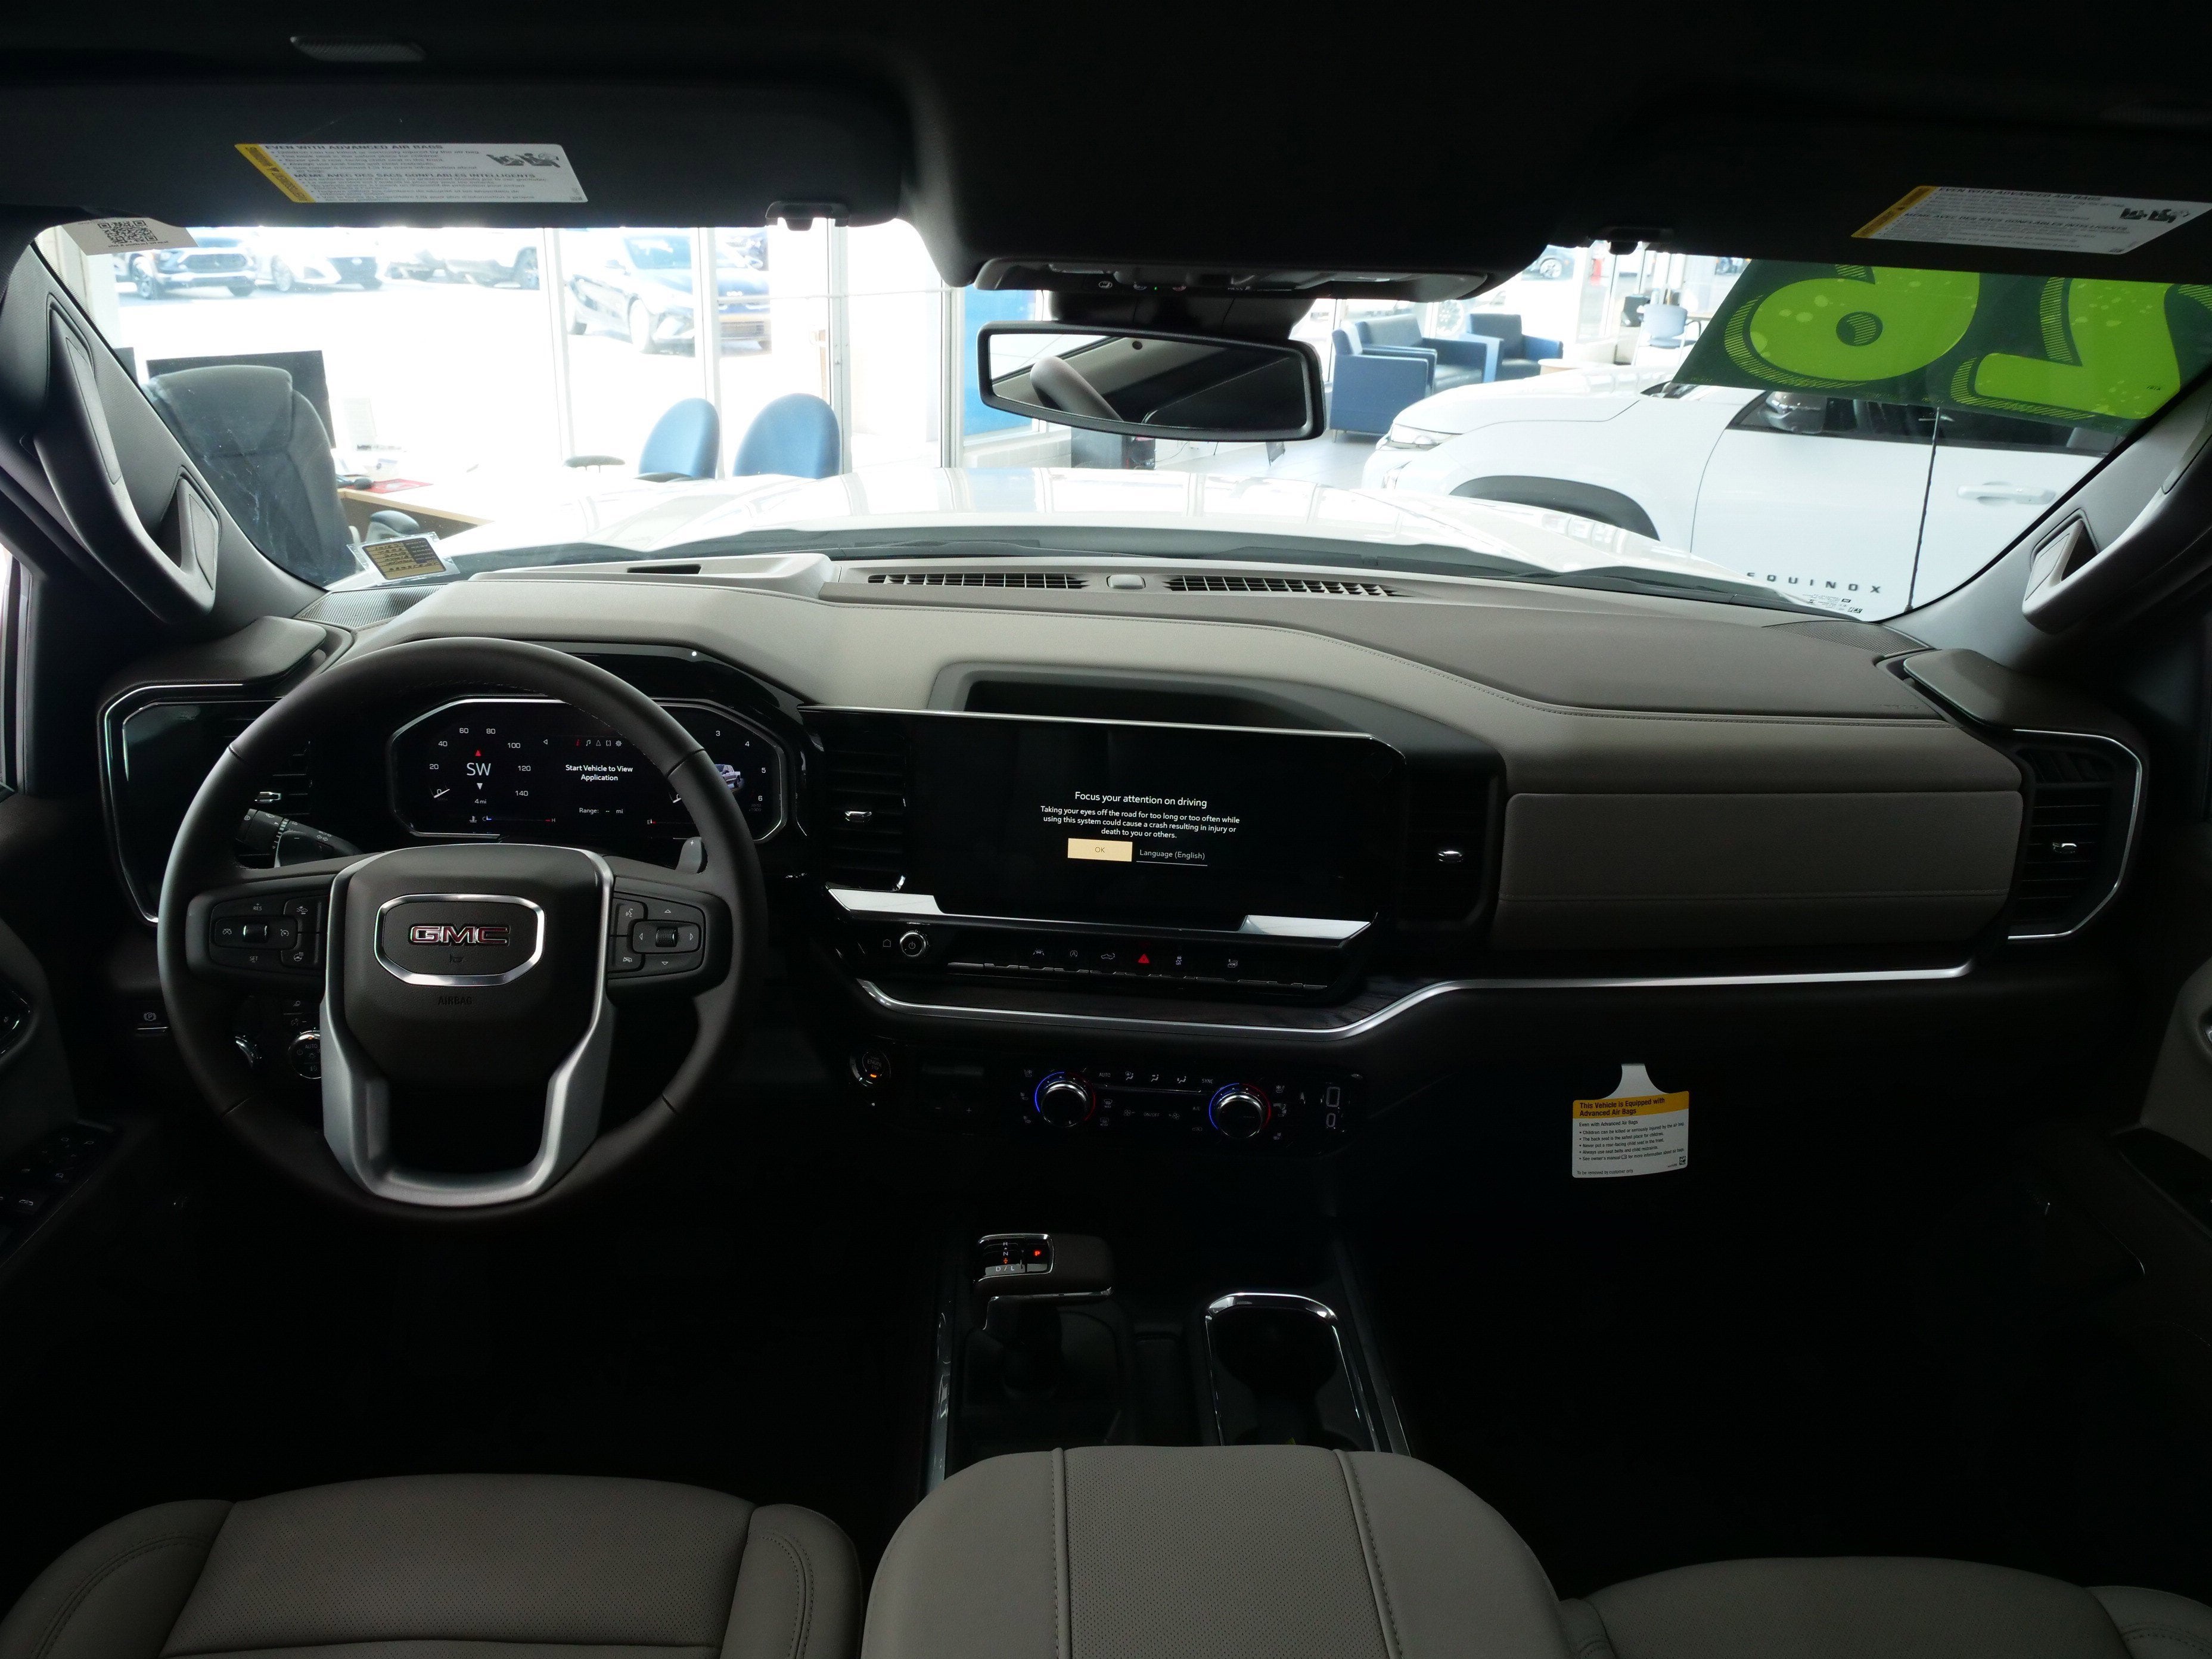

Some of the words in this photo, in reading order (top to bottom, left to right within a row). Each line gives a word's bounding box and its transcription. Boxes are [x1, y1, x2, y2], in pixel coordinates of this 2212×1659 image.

[1747, 572, 1881, 594] EQUINOX
[467, 763, 492, 776] SW
[580, 773, 619, 782] Application
[1075, 791, 1100, 801] Focus
[1101, 794, 1121, 803] your
[1123, 795, 1162, 805] attention
[1177, 797, 1208, 809] driving
[1040, 806, 1062, 815] Taking
[1063, 808, 1079, 816] your
[1080, 809, 1096, 817] eyes
[1163, 812, 1179, 821] long
[1201, 814, 1220, 822] often
[1222, 815, 1240, 824] while
[1043, 816, 1062, 825] using
[1077, 818, 1101, 827] system
[1169, 822, 1199, 832] resulting
[1208, 824, 1227, 834] injury
[1101, 827, 1120, 835] death
[1153, 830, 1178, 838] others.
[1139, 849, 1173, 859] Language
[1174, 850, 1205, 861] (English)
[409, 924, 511, 946] GMC
[438, 996, 472, 1005] AIRBAG
[1625, 1099, 1652, 1108] Equipped
